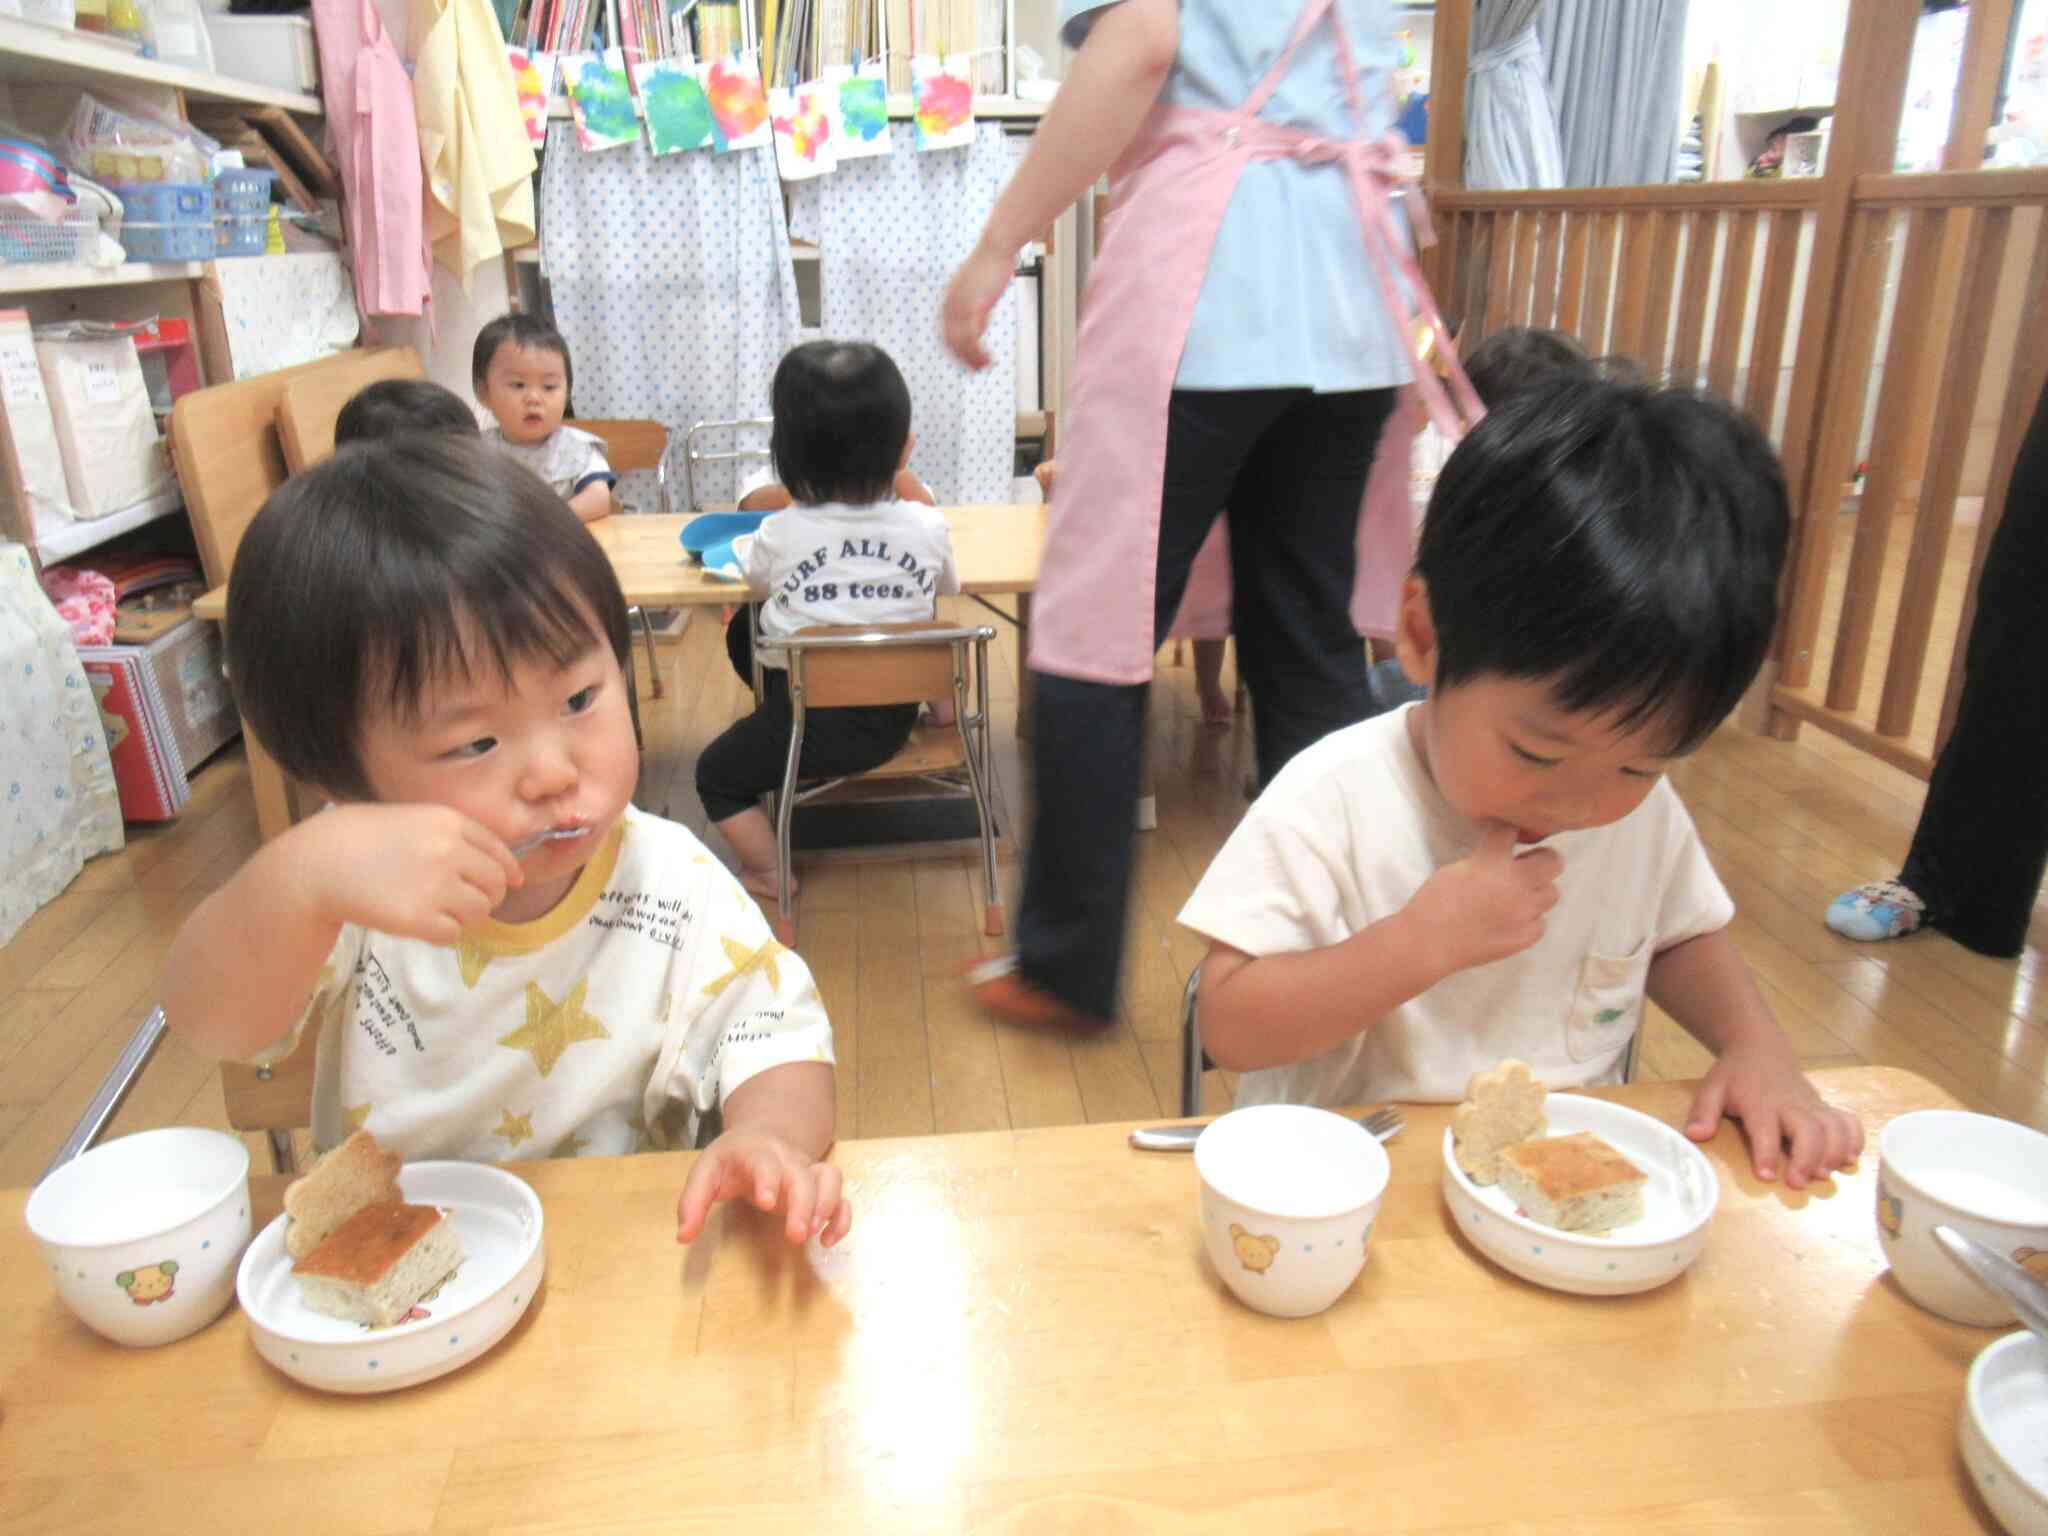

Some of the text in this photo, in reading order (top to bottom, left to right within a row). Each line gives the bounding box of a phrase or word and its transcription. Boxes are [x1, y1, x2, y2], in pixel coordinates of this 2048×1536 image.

[839, 538, 892, 562] ALL
[803, 582, 914, 602] 88 tees.
